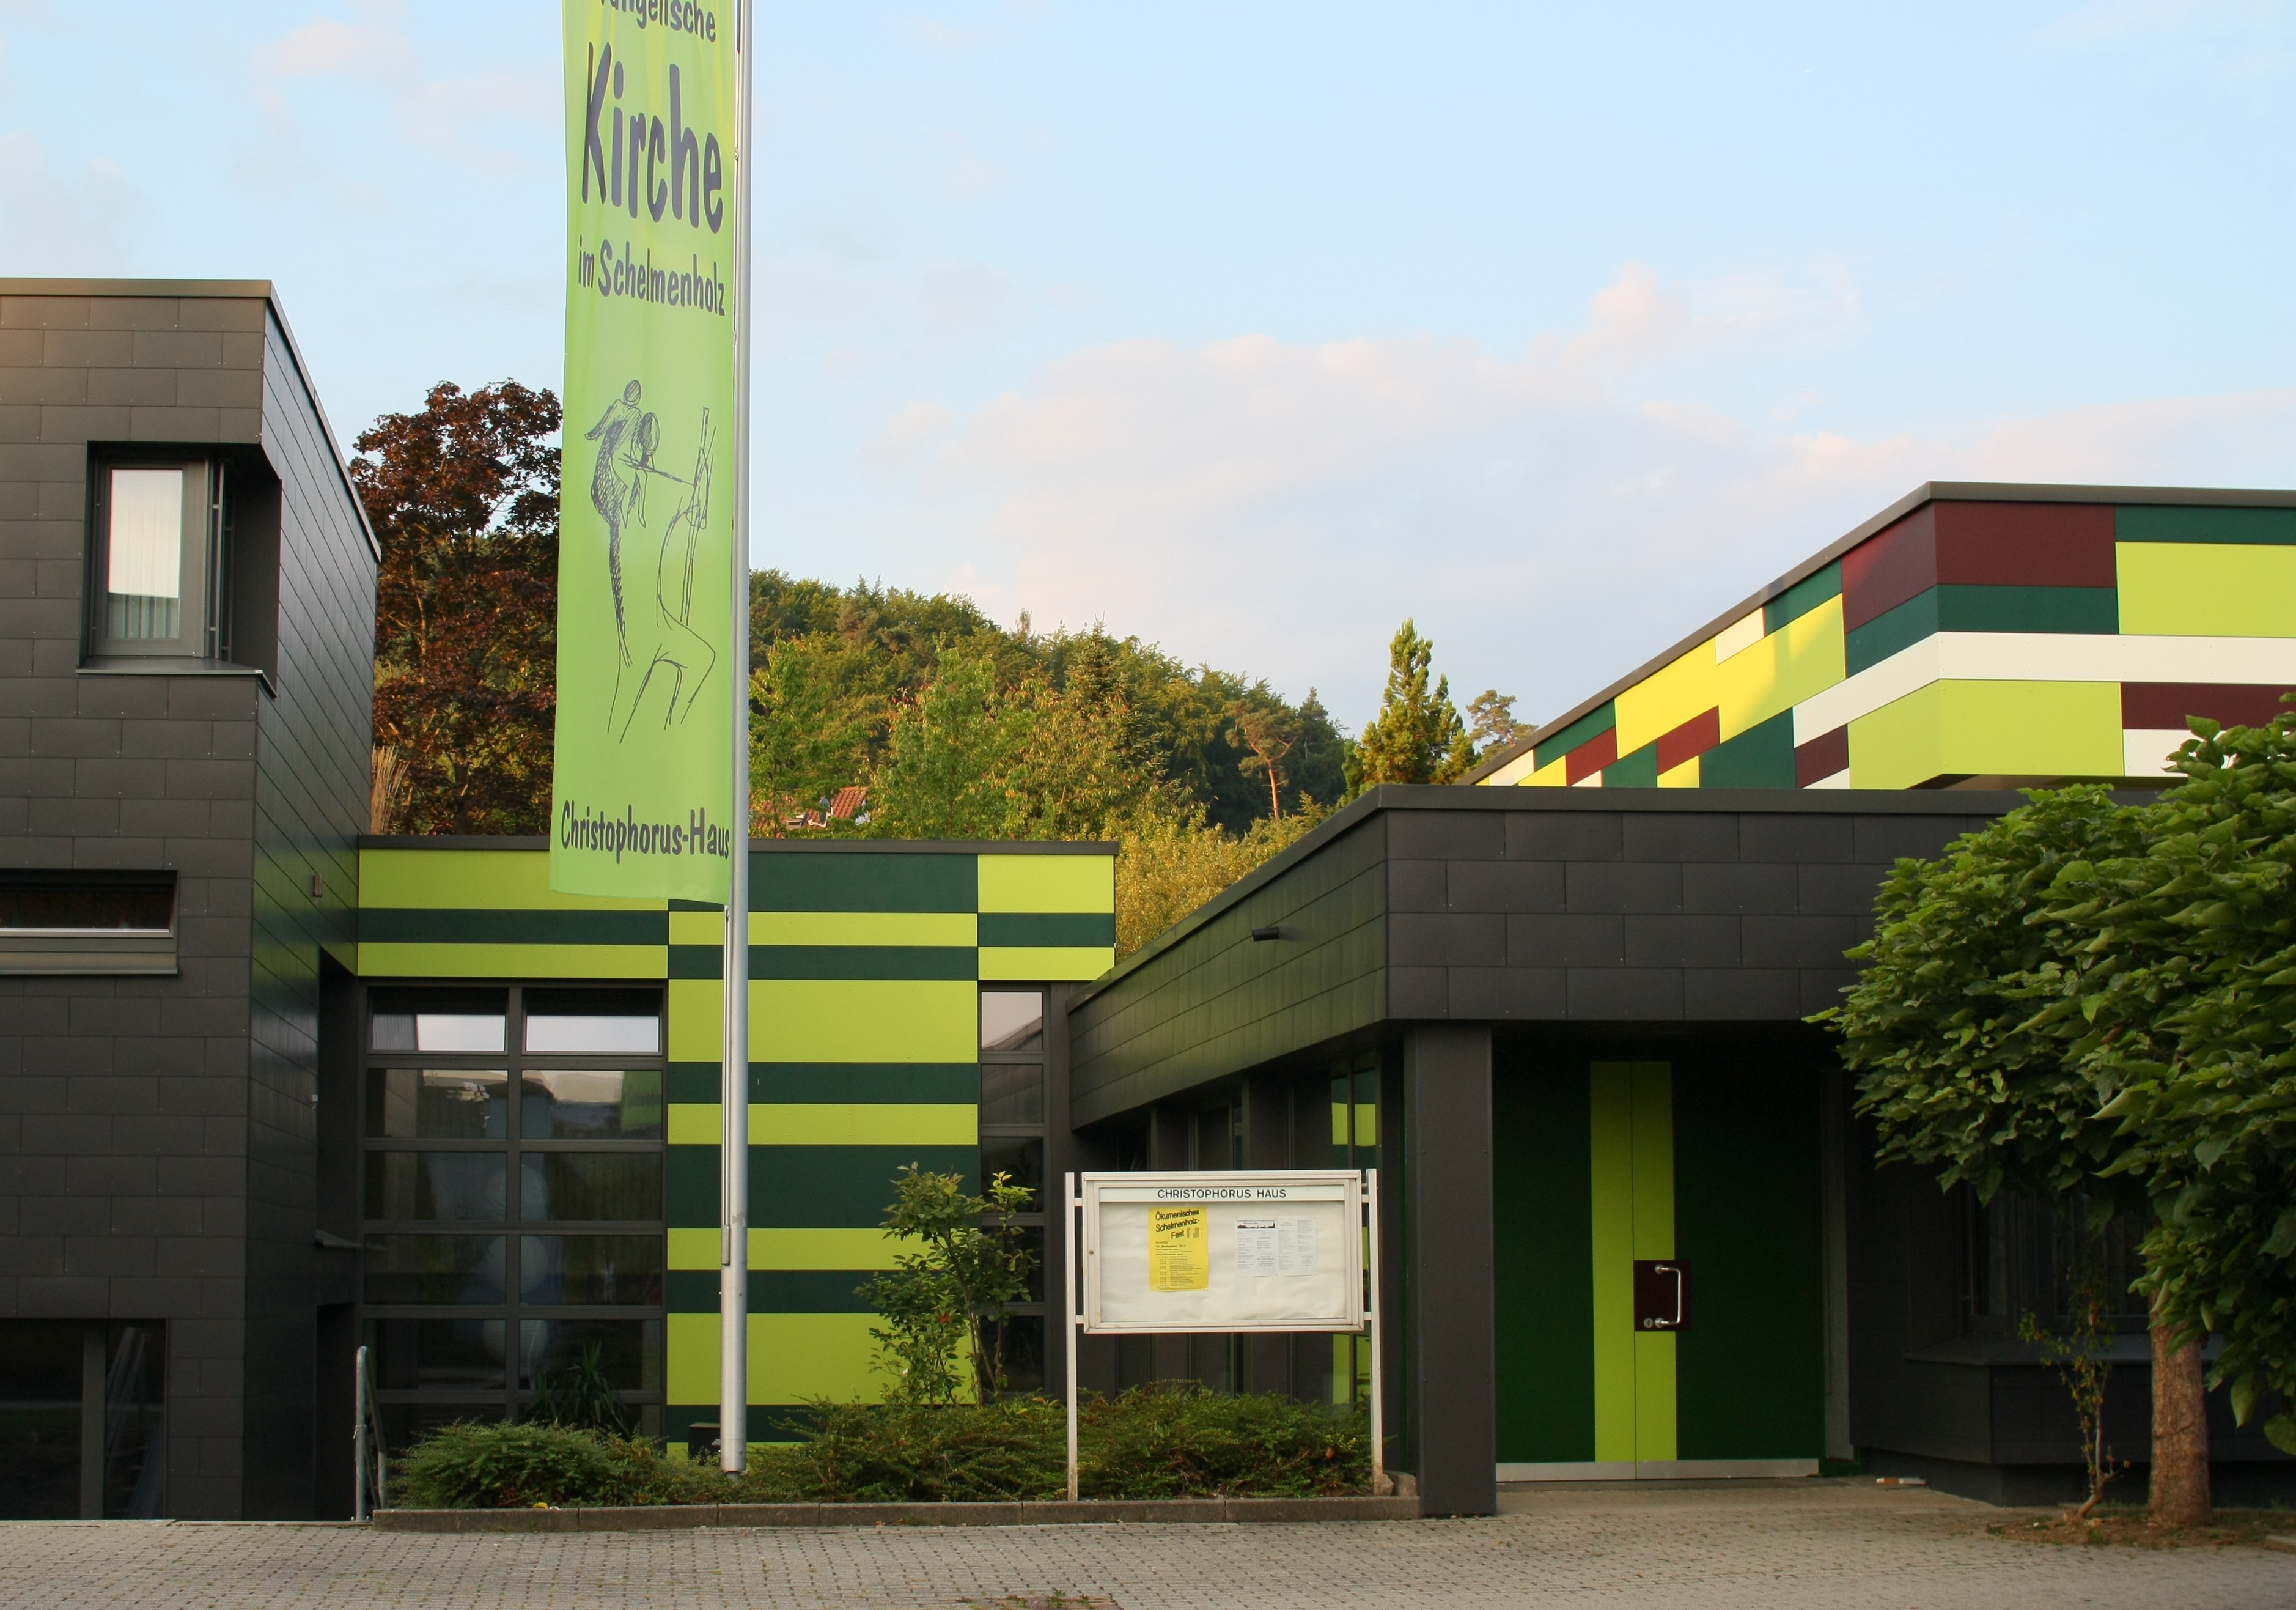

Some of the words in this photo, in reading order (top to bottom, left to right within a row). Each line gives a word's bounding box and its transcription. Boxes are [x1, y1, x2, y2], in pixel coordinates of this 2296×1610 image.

[600, 0, 716, 43] gelische
[582, 41, 724, 234] Kirche
[578, 234, 595, 289] im
[598, 239, 726, 317] Schelmenholz
[561, 799, 730, 865] Christophorus-Haus
[1157, 1189, 1252, 1198] CHRISTOPHORUS
[1257, 1189, 1287, 1198] HAUS
[1155, 1209, 1199, 1221] Ökumenisches
[1155, 1217, 1200, 1233] Schelmenholz-
[1171, 1229, 1185, 1240] Fest
